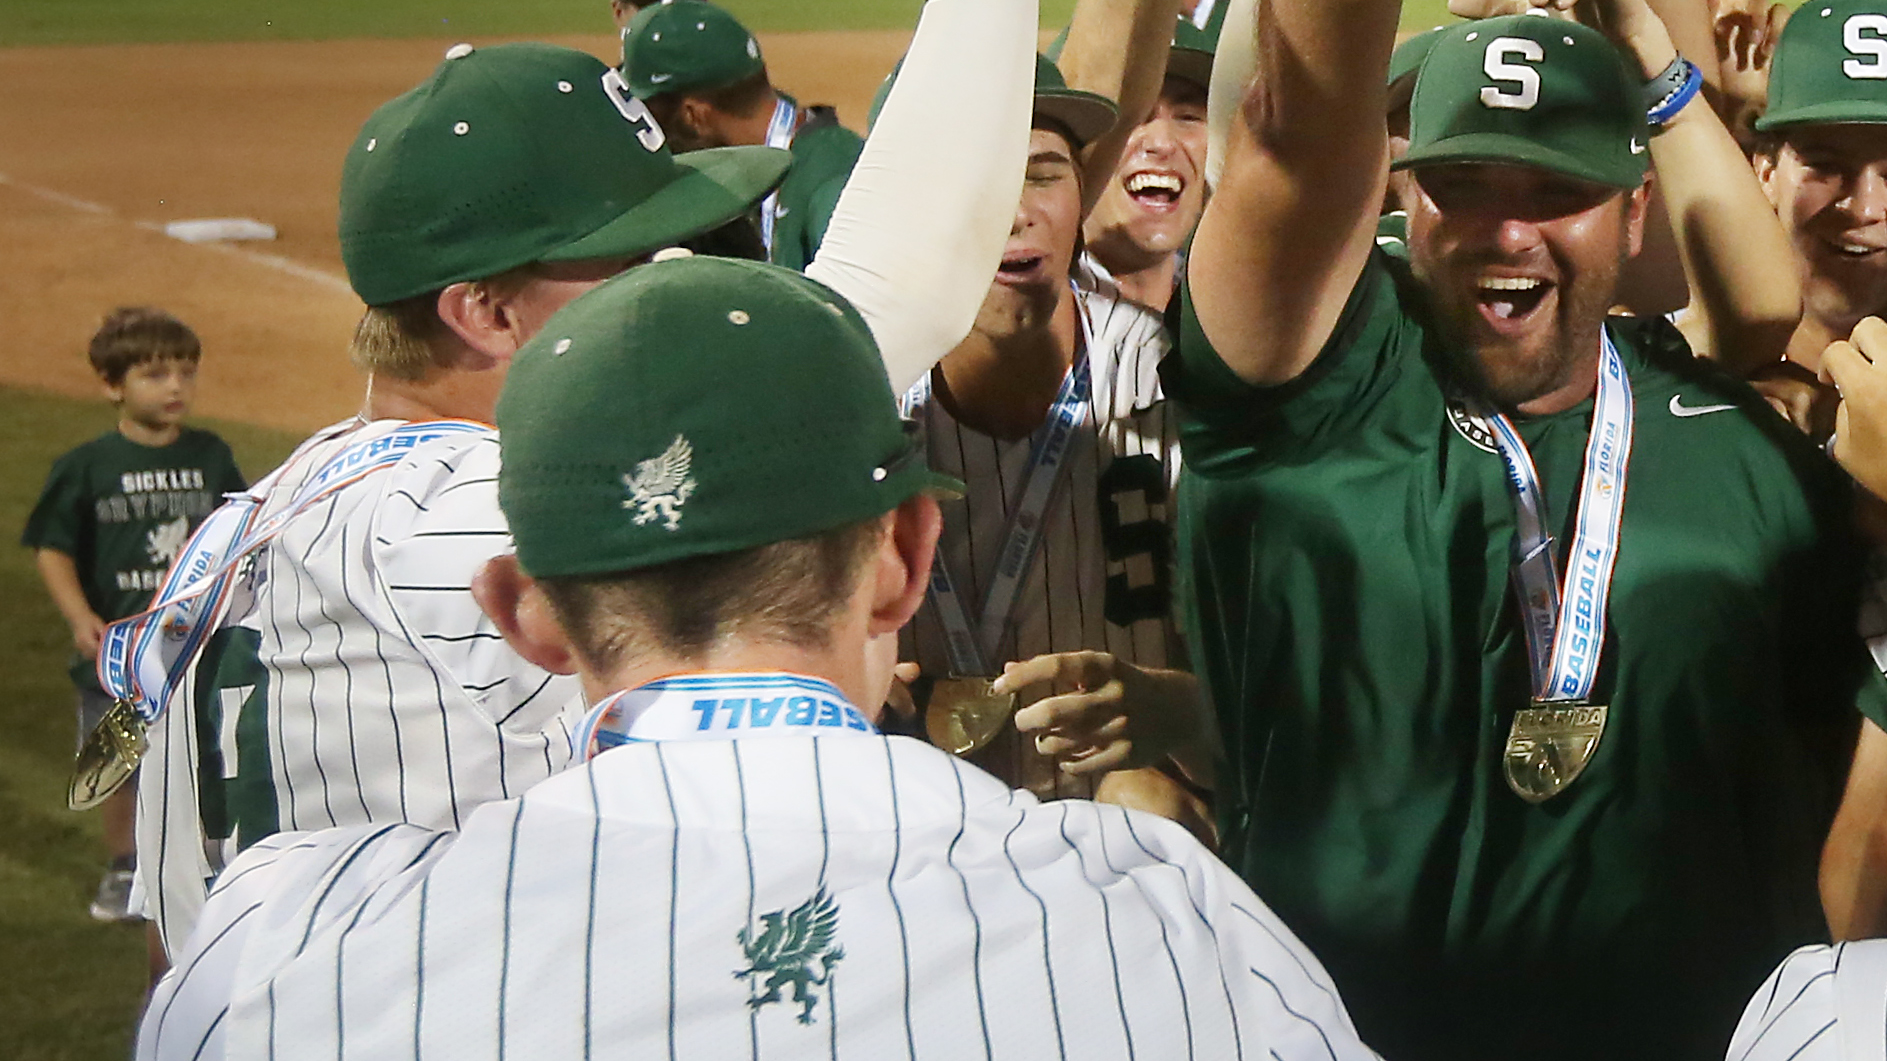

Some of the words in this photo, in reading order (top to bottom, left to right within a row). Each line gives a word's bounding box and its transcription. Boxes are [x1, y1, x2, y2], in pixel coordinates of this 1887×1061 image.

[601, 67, 667, 153] S
[1480, 36, 1545, 112] S
[121, 468, 204, 494] SICKLES
[1599, 421, 1616, 471] FLORIDA
[1561, 547, 1602, 698] BASEBALL
